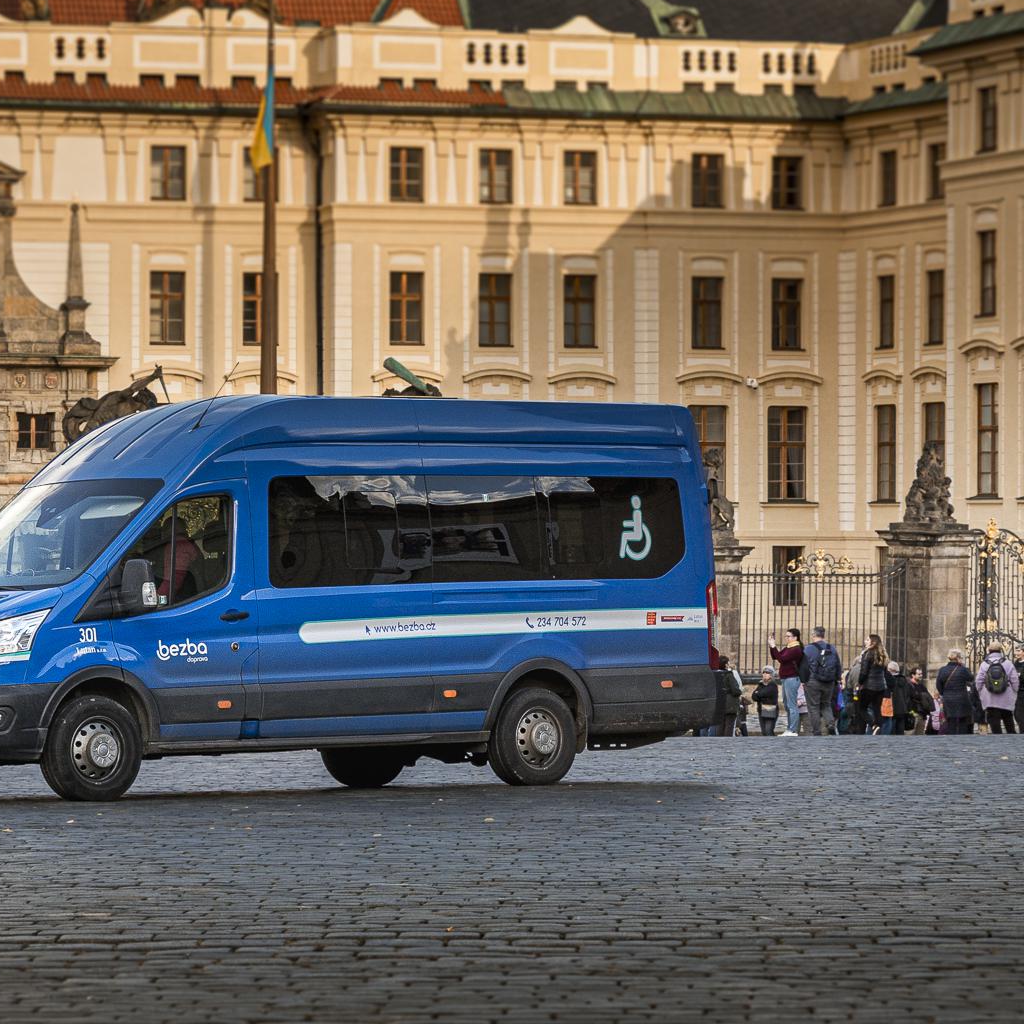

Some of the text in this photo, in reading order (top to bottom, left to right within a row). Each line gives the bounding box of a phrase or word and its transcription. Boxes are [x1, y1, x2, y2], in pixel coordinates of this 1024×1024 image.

[374, 621, 436, 633] www.bezba.cz
[537, 616, 586, 627] 234 704 572
[79, 627, 97, 642] 301
[156, 637, 208, 660] bezba
